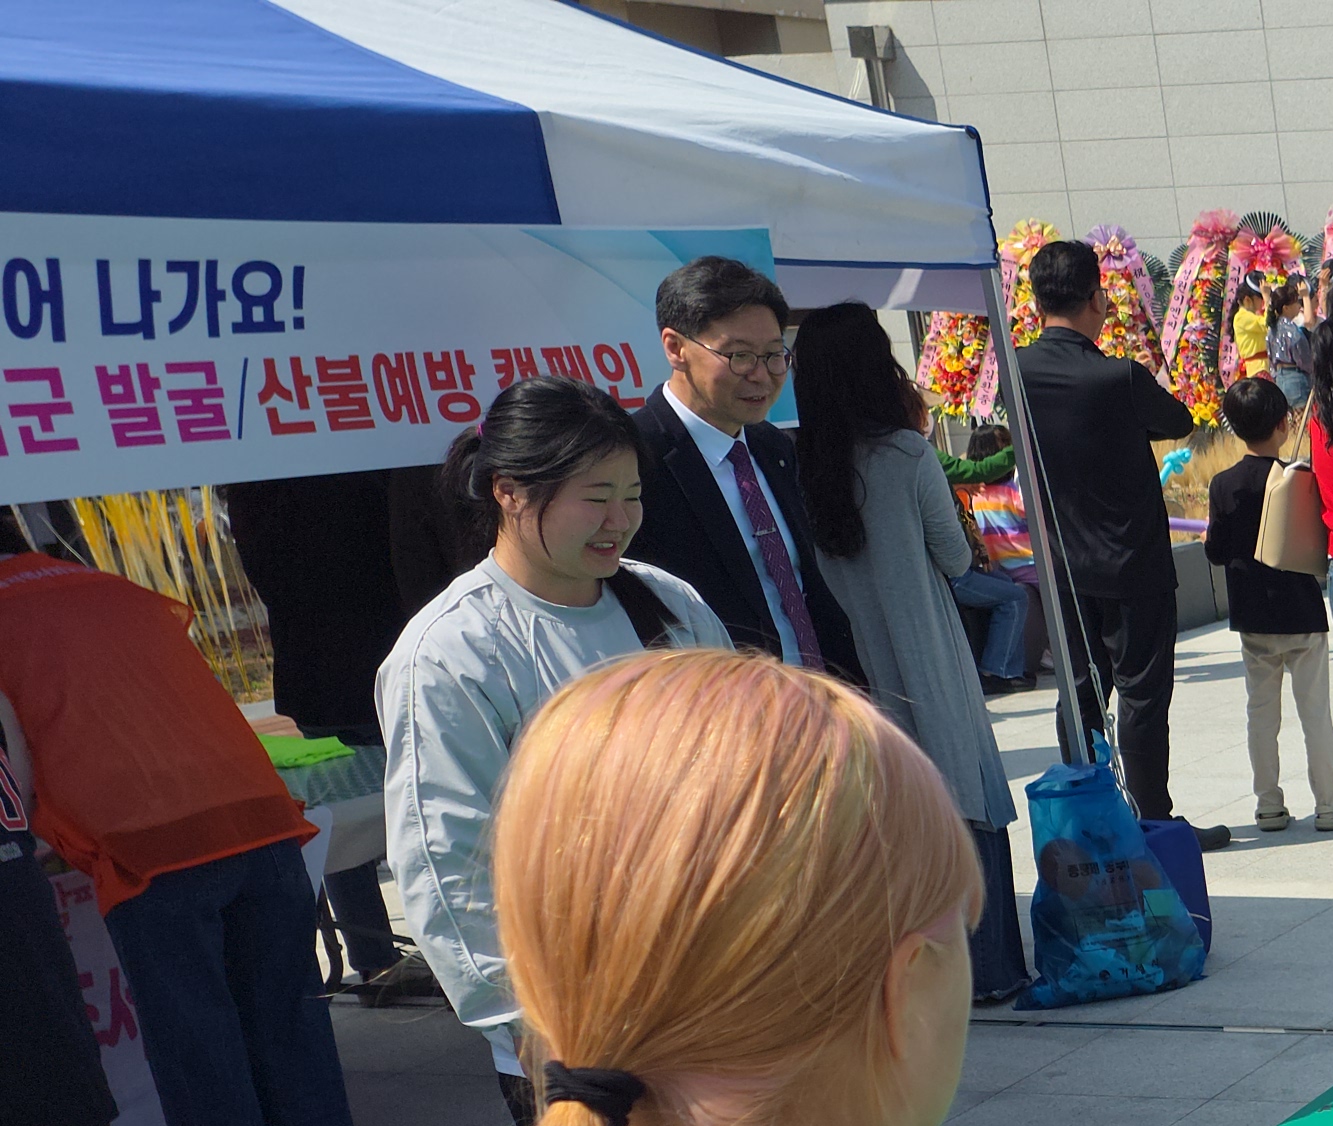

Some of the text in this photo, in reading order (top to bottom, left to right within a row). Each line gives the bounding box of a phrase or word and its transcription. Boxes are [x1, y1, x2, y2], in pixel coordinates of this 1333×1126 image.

[2, 257, 305, 343] 어 나가요!
[0, 366, 81, 457] 군
